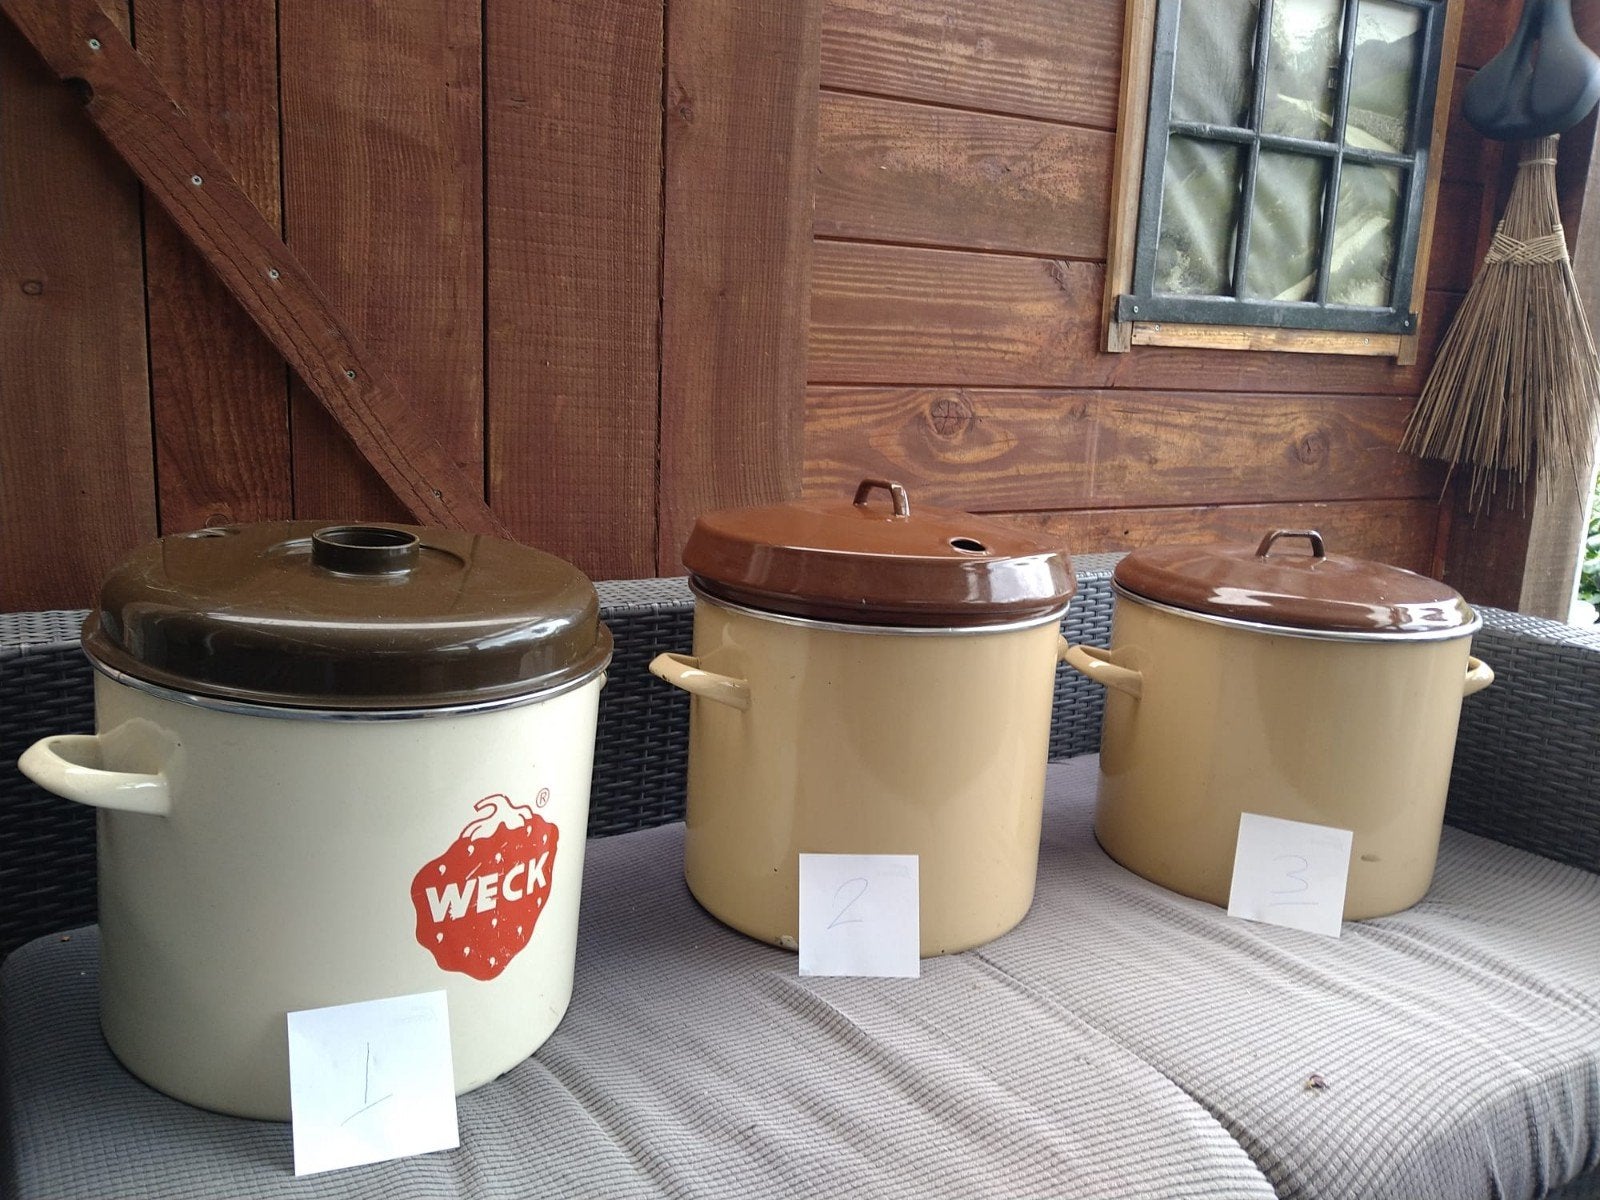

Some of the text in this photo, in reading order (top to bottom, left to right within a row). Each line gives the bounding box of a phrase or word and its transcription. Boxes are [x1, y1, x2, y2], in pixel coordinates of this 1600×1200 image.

[425, 850, 549, 923] WECK
[1269, 854, 1309, 895] 3
[827, 877, 868, 930] 2
